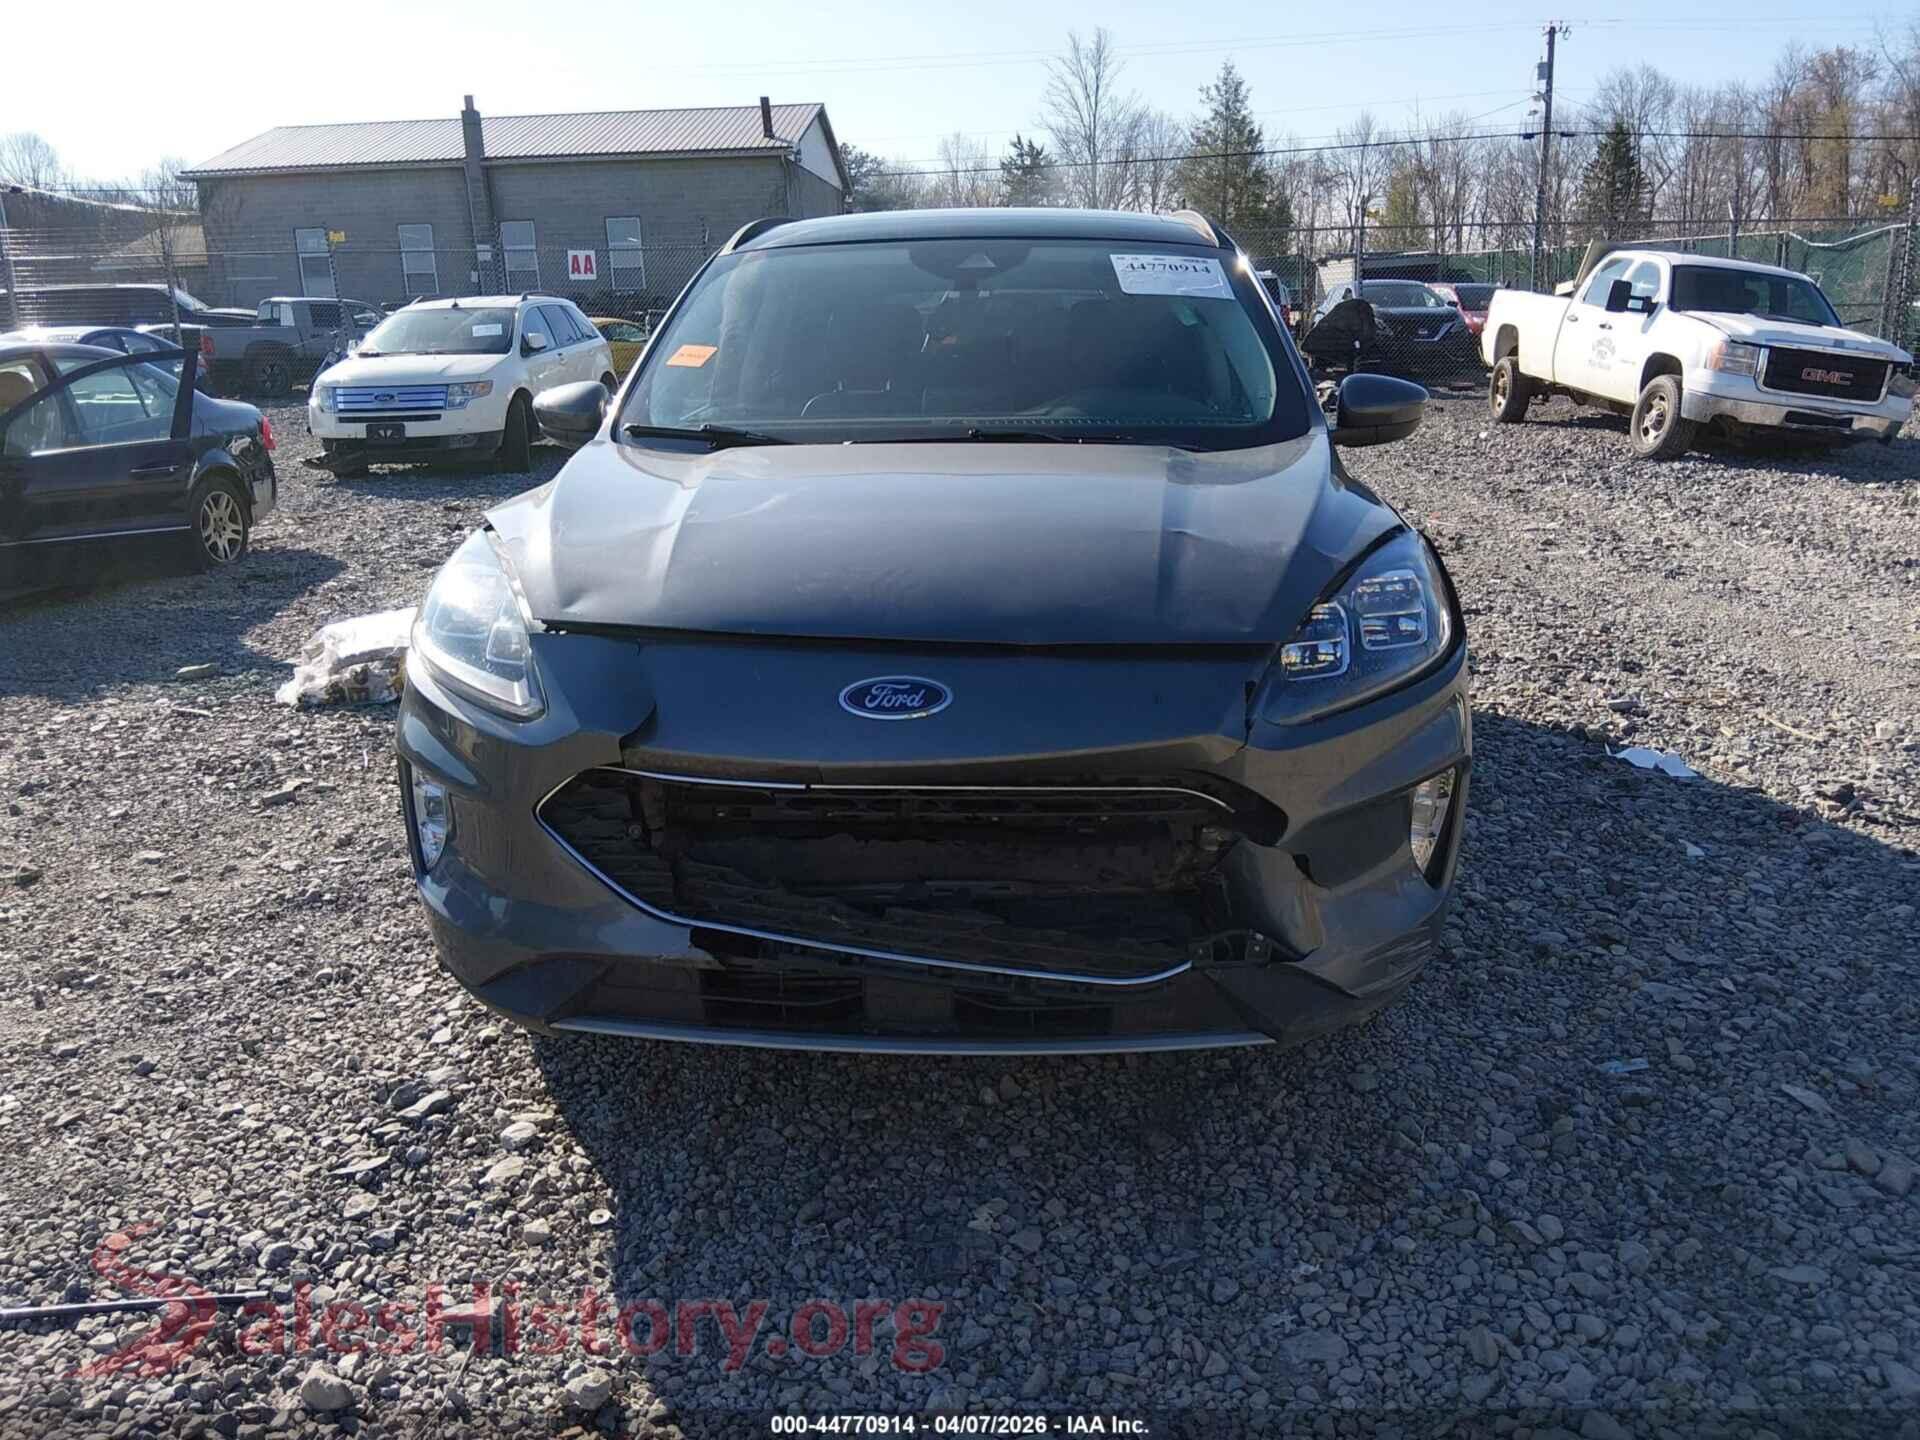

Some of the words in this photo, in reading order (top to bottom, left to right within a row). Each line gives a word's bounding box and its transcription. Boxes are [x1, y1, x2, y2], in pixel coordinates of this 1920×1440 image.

[571, 254, 594, 275] AA
[1124, 263, 1211, 274] 44770914
[1801, 367, 1854, 386] GMC
[865, 683, 927, 708] Ford
